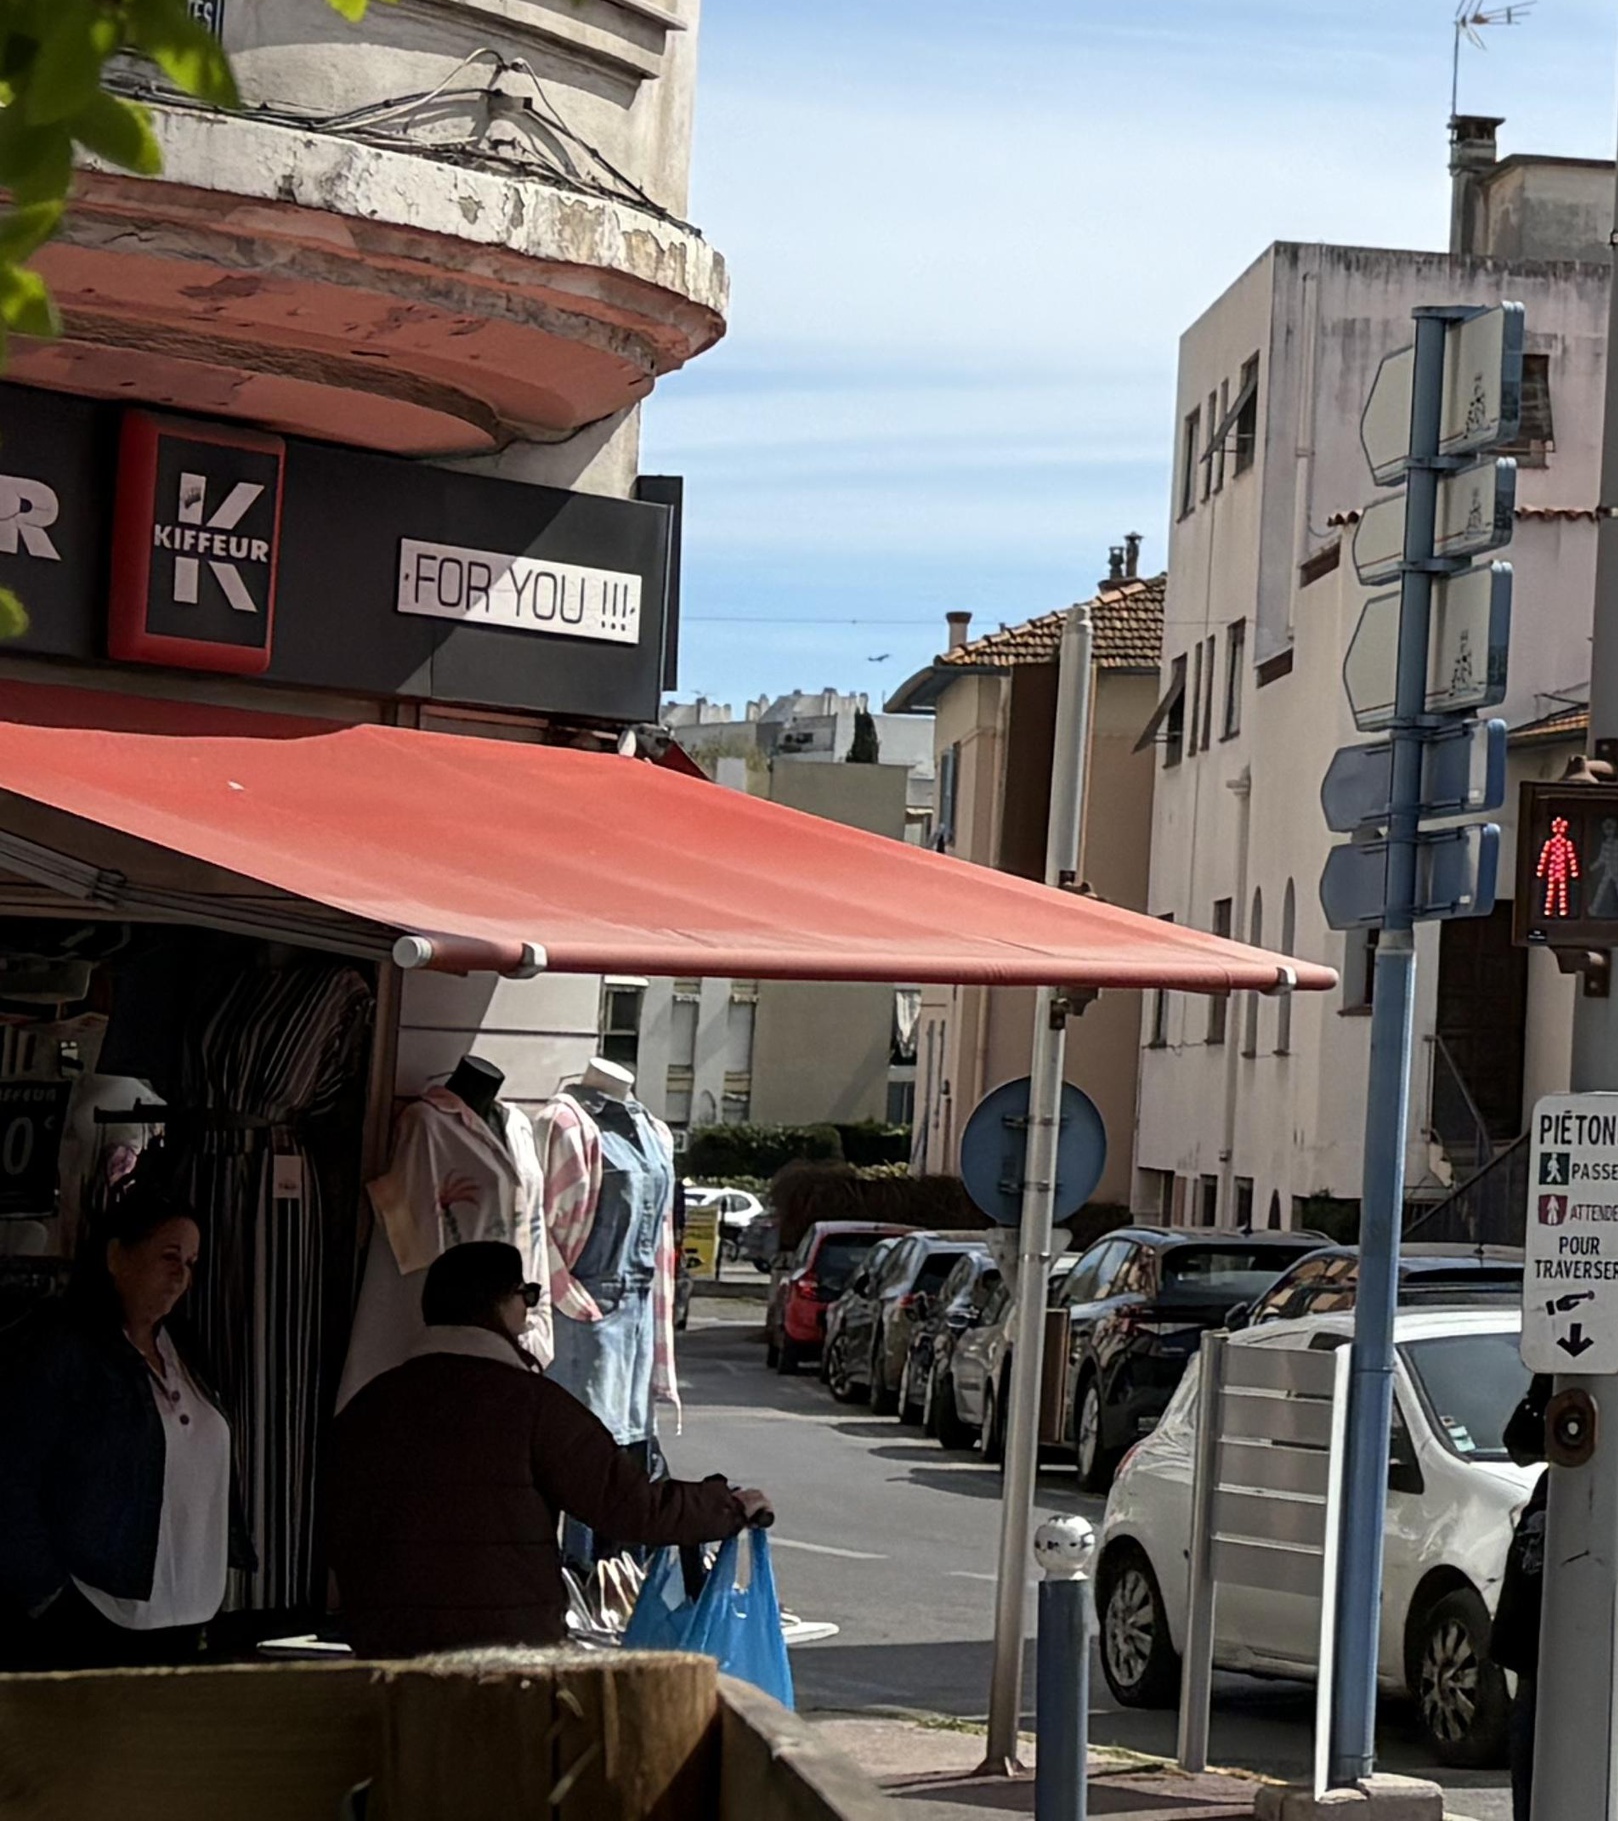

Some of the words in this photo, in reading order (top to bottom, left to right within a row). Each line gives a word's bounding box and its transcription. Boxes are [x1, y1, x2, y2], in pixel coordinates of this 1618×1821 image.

[0, 474, 62, 561] R
[153, 523, 269, 563] KIFFEUR
[414, 553, 492, 613] FOR
[508, 566, 585, 624] YOU
[601, 580, 628, 631] !!!
[1559, 1236, 1600, 1255] POUR
